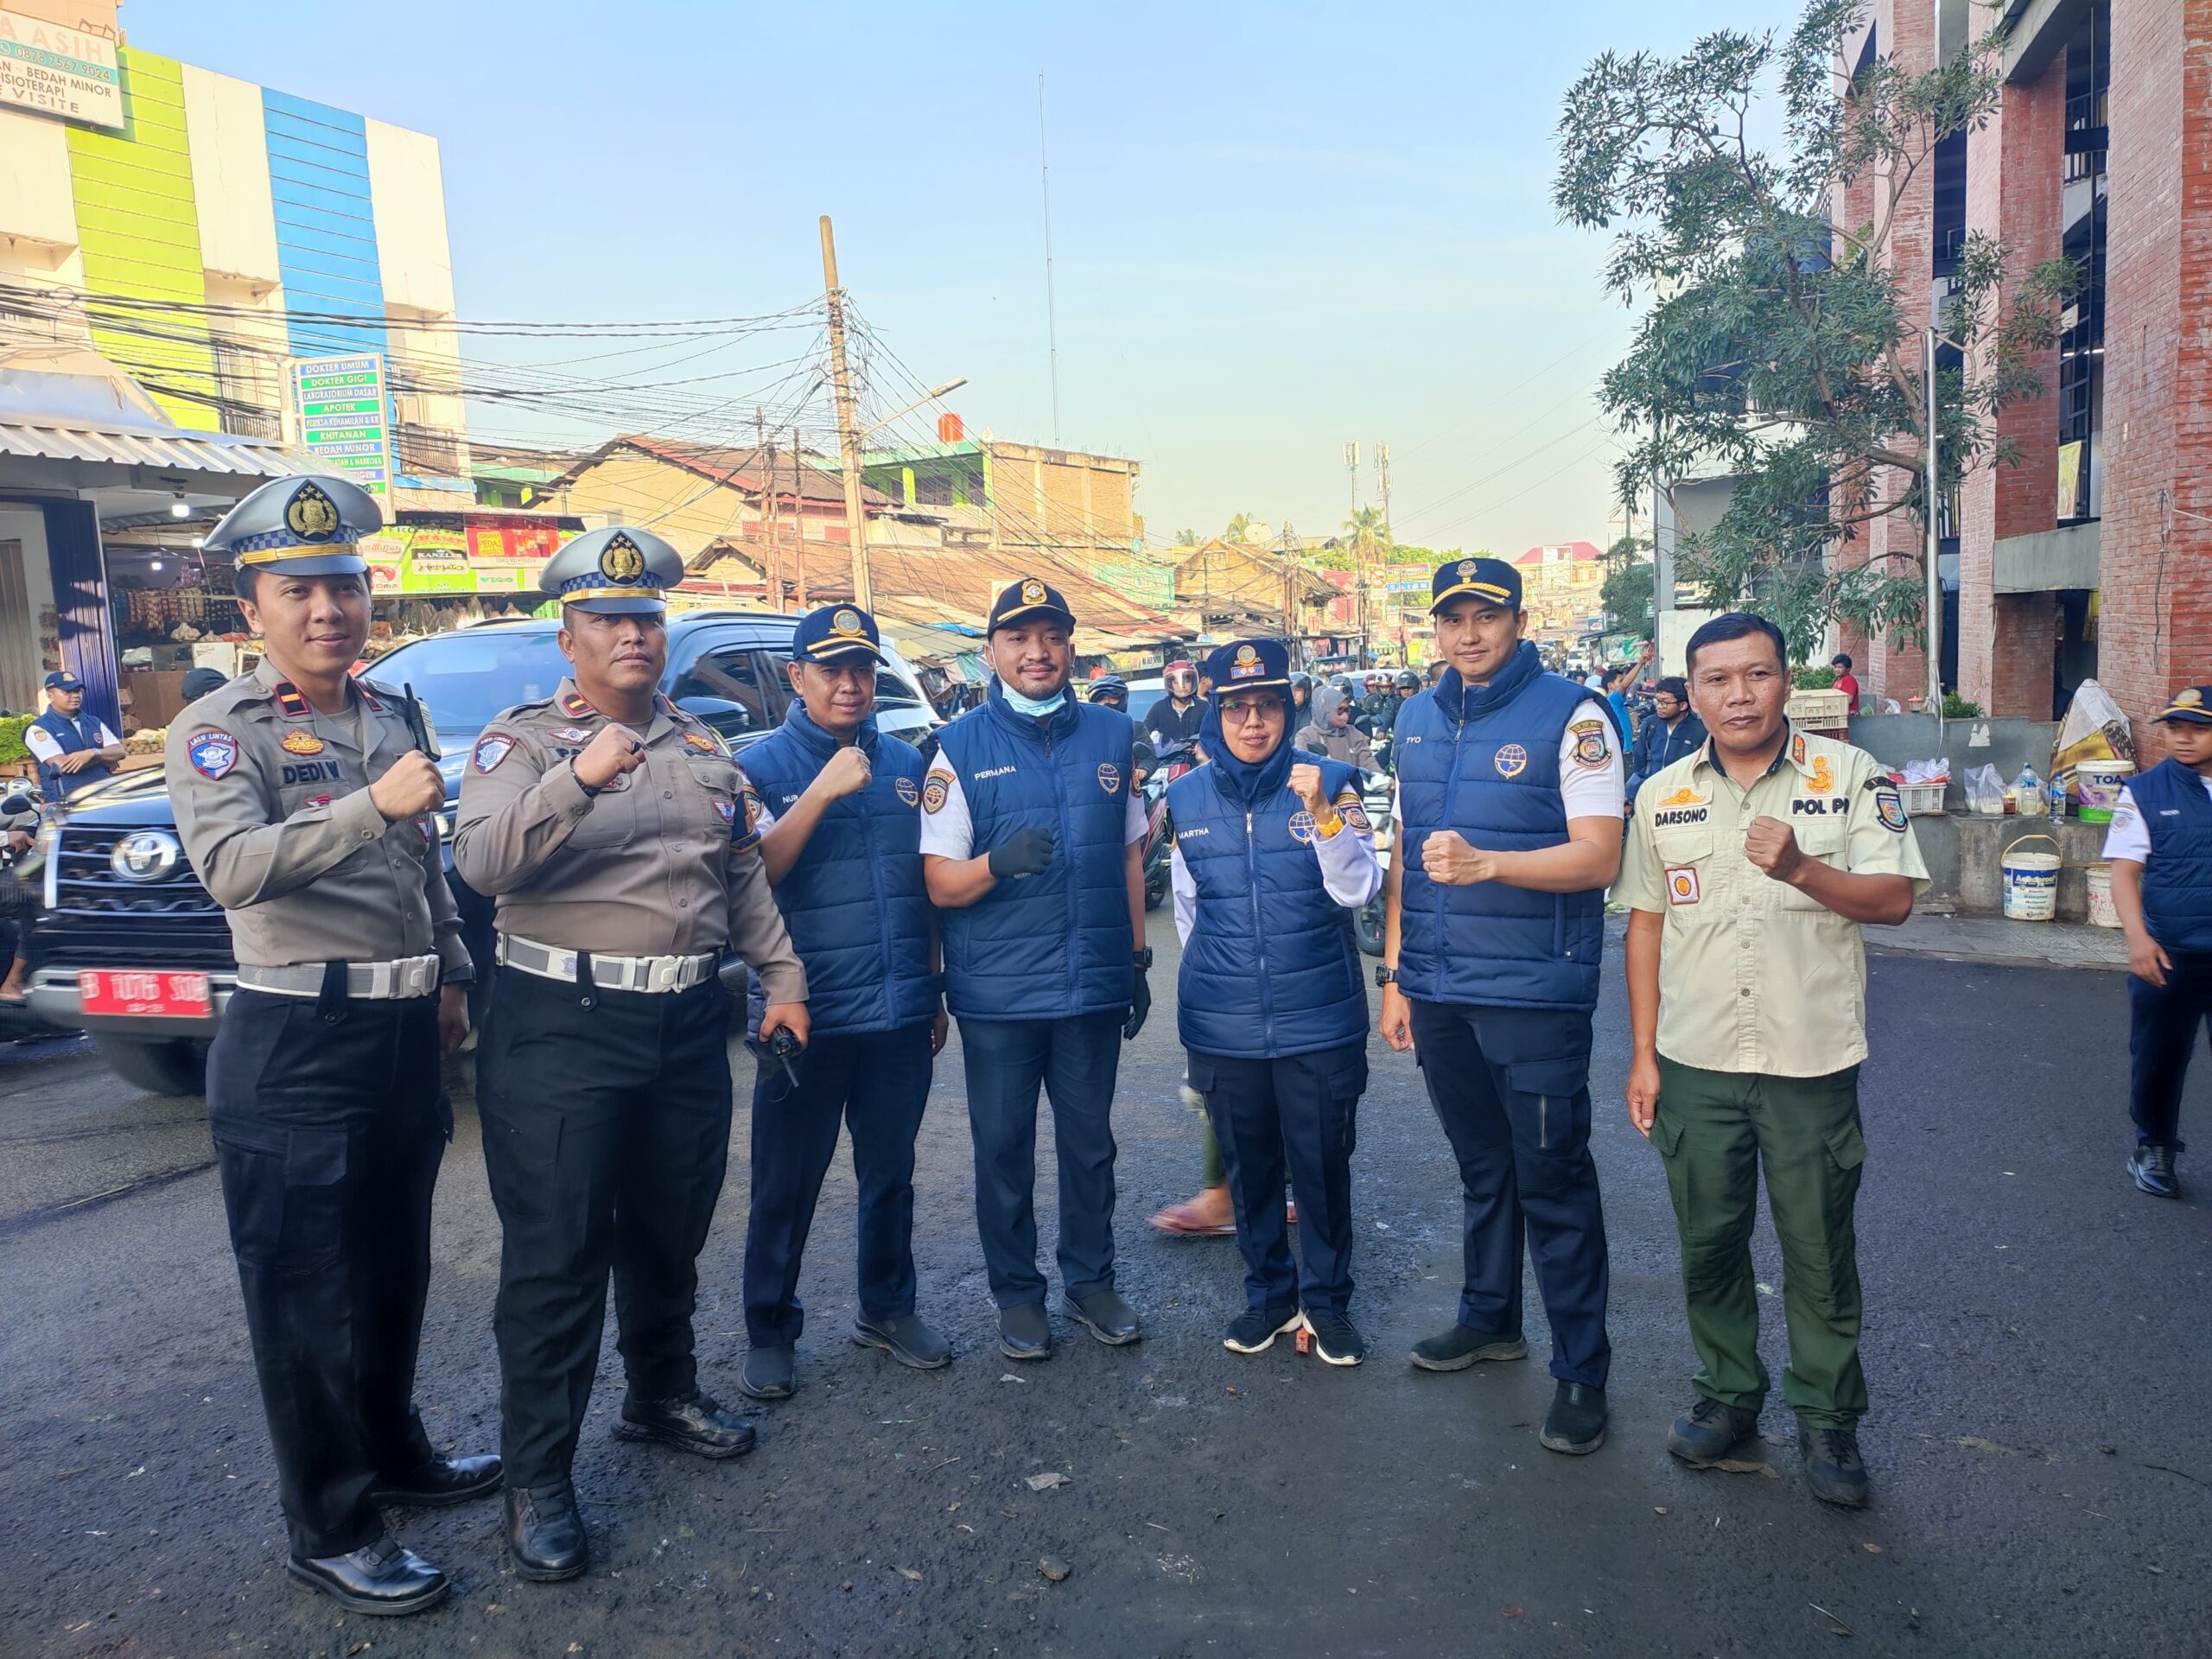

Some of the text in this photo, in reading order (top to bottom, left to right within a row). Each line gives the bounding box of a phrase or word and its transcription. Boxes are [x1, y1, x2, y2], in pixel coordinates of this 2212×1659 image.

[31, 26, 103, 64] ASIH
[16, 47, 111, 80] 0878 7567 9024
[0, 72, 65, 98] ISIOTERAPI
[27, 67, 67, 86] BEDAH
[70, 78, 111, 98] MINOR
[12, 87, 79, 113] VISITE
[306, 360, 370, 373] DOKTER UMUM
[311, 373, 367, 387] DOKTER GIGI
[303, 388, 377, 401] LABORATORIUM DASAR
[323, 402, 356, 413] APOTEK
[320, 430, 366, 441] KHITANAN
[315, 443, 375, 455] BEDAH MINOR
[189, 733, 233, 747] LALU LINTAS
[282, 760, 340, 785] DEDI W
[974, 765, 1017, 781] PERMANA
[2094, 774, 2122, 785] TOA
[1792, 798, 1827, 815] POL
[1655, 808, 1707, 827] DARSONO
[1178, 826, 1210, 841] MARTHA
